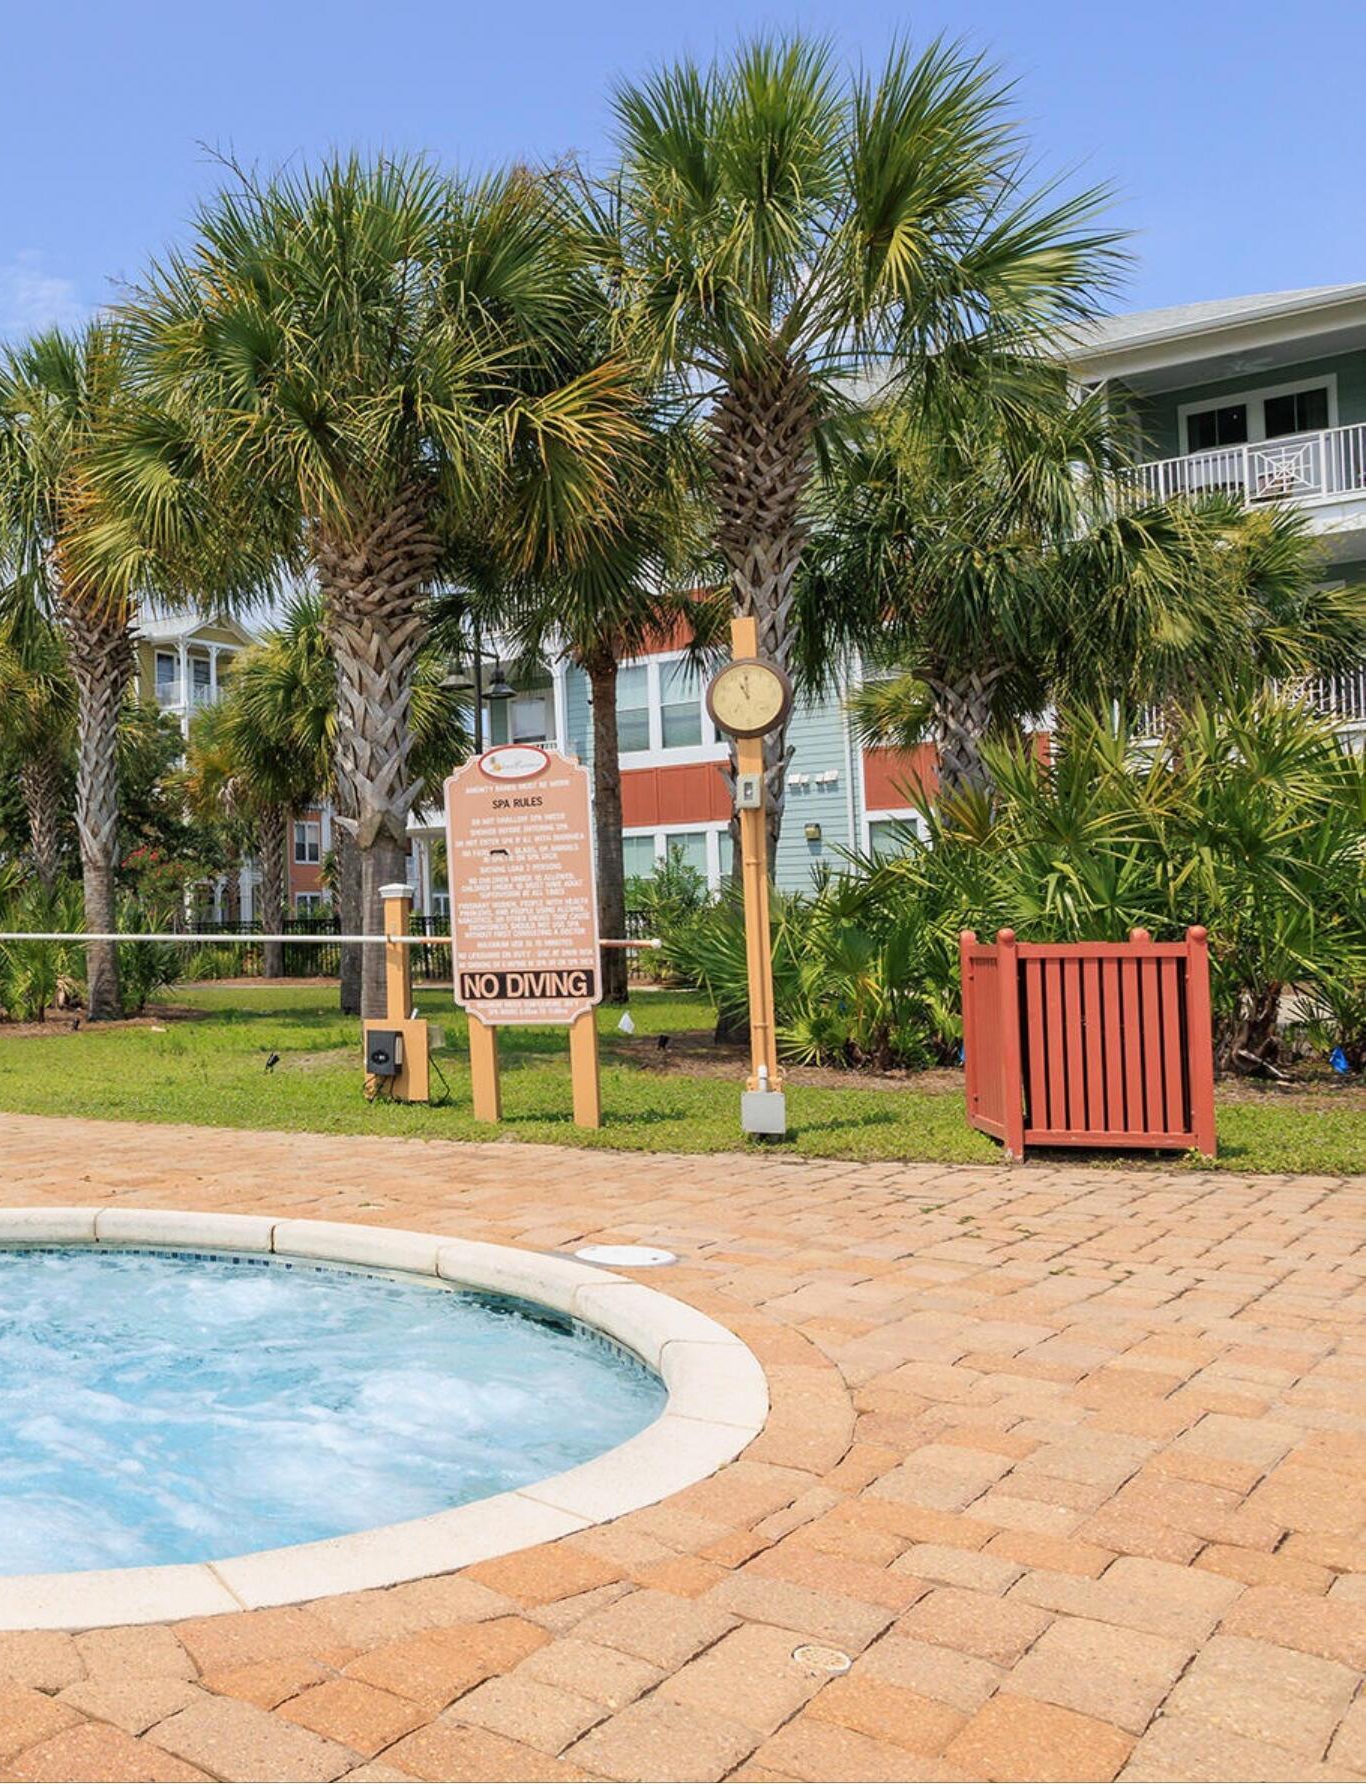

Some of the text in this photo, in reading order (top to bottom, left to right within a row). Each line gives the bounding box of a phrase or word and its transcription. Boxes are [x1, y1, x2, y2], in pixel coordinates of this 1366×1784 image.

[492, 796, 543, 809] SPA RULES
[464, 972, 587, 998] NO DIVING
